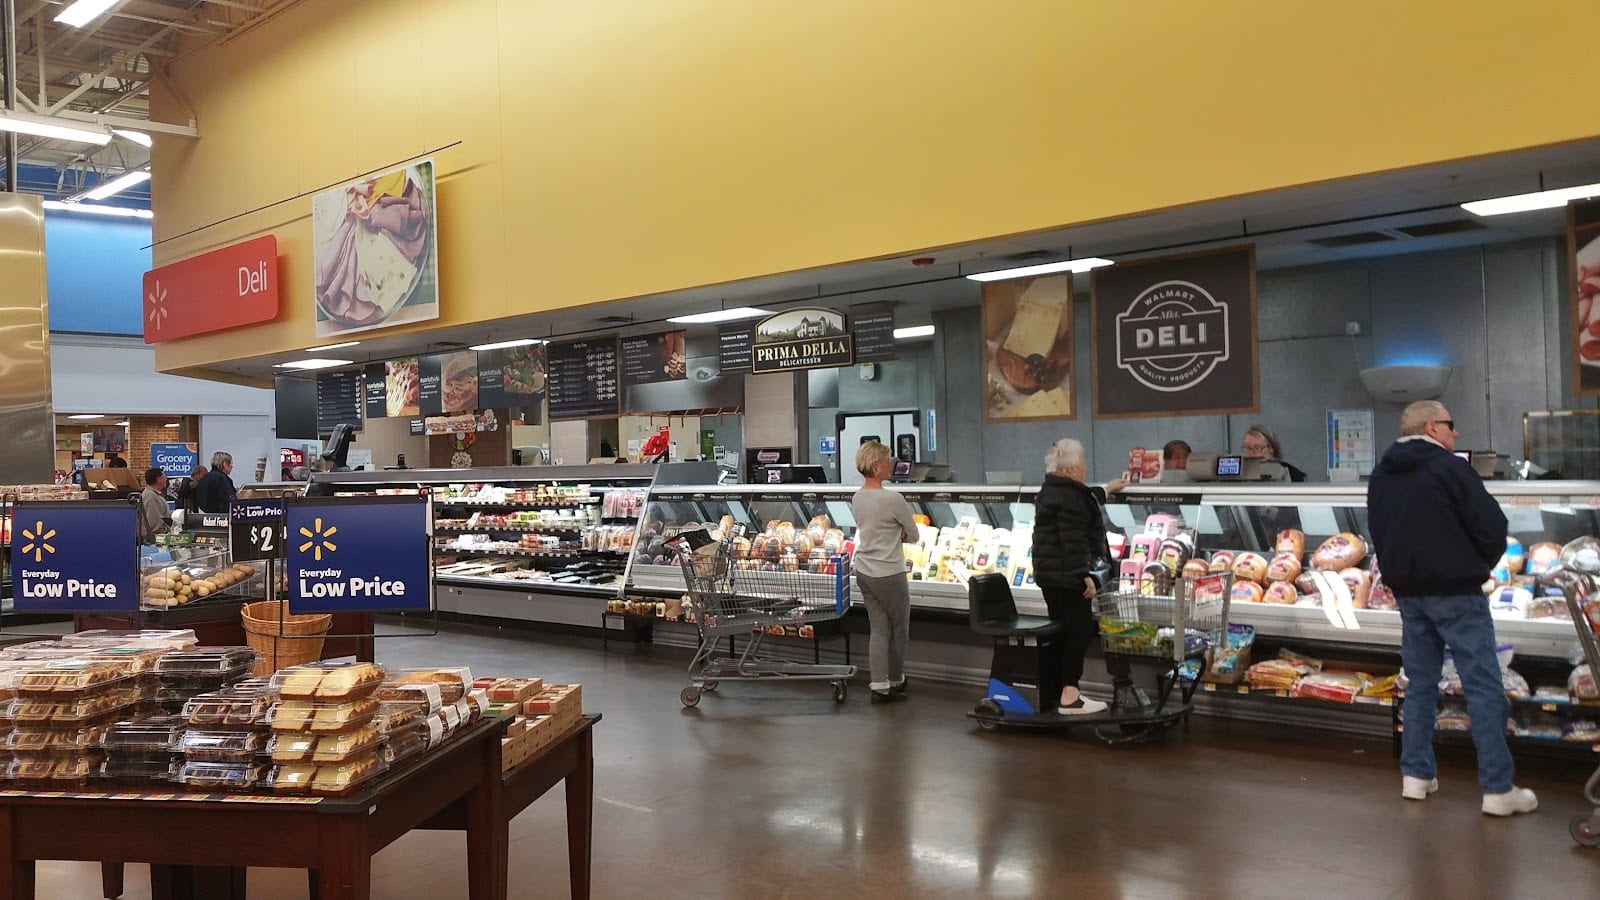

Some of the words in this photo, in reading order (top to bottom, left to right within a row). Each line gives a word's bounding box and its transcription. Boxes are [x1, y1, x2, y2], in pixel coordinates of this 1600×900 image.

[238, 260, 268, 297] Deli
[1144, 289, 1196, 306] WALMART
[1136, 322, 1207, 349] DELI
[757, 345, 799, 362] PRIMA
[802, 340, 846, 357] DELLA
[779, 357, 821, 367] DELICATESSEN
[1140, 363, 1167, 382] QUALITY
[1170, 360, 1206, 383] PRODUCTS
[156, 453, 192, 465] Grocery
[160, 462, 191, 474] pickup
[246, 508, 264, 517] Low
[265, 507, 286, 516] Pric
[22, 569, 61, 580] Everyday
[299, 568, 342, 579] Everyday
[23, 579, 64, 598] Low
[66, 579, 117, 598] Price
[300, 579, 346, 598] Low
[350, 576, 406, 597] Price
